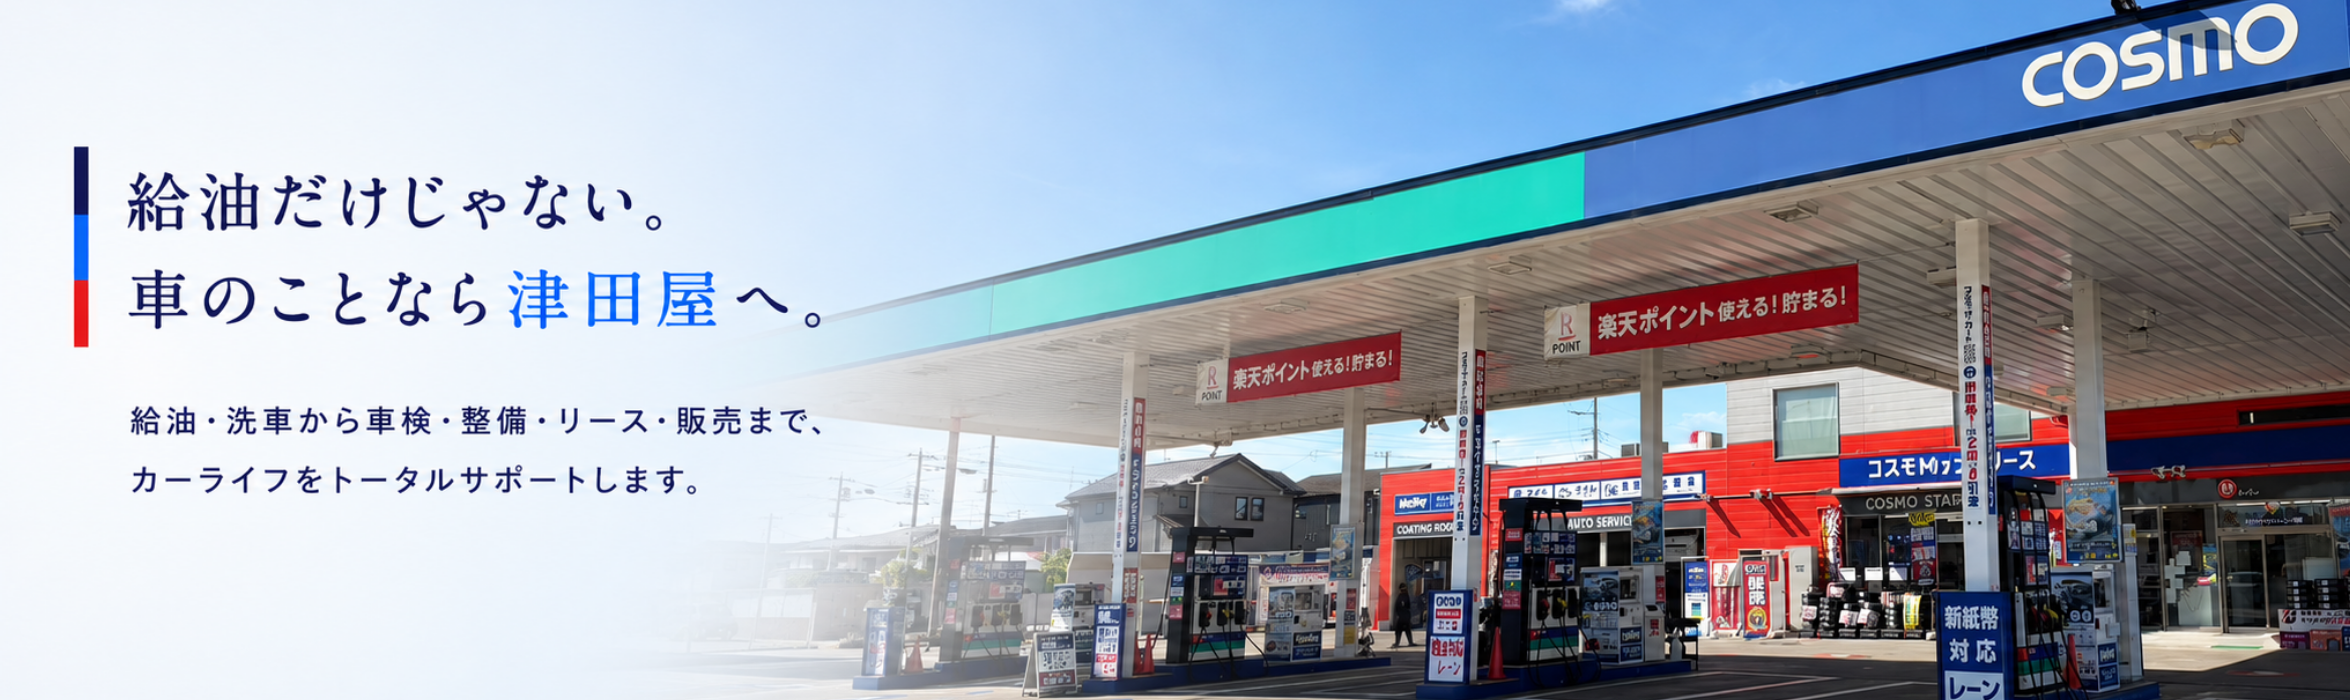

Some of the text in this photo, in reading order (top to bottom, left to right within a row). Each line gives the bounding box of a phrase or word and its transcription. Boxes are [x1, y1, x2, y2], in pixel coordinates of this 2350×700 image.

[2021, 2, 2299, 107] COSMO
[1552, 340, 1581, 354] POINT
[1201, 390, 1222, 401] POINT
[1865, 495, 1918, 511] COSMO
[1596, 515, 1632, 528] SERVIC
[1944, 605, 1999, 631] 新紙幣
[1949, 638, 1997, 663] 対応
[1949, 677, 2001, 700] レーン
